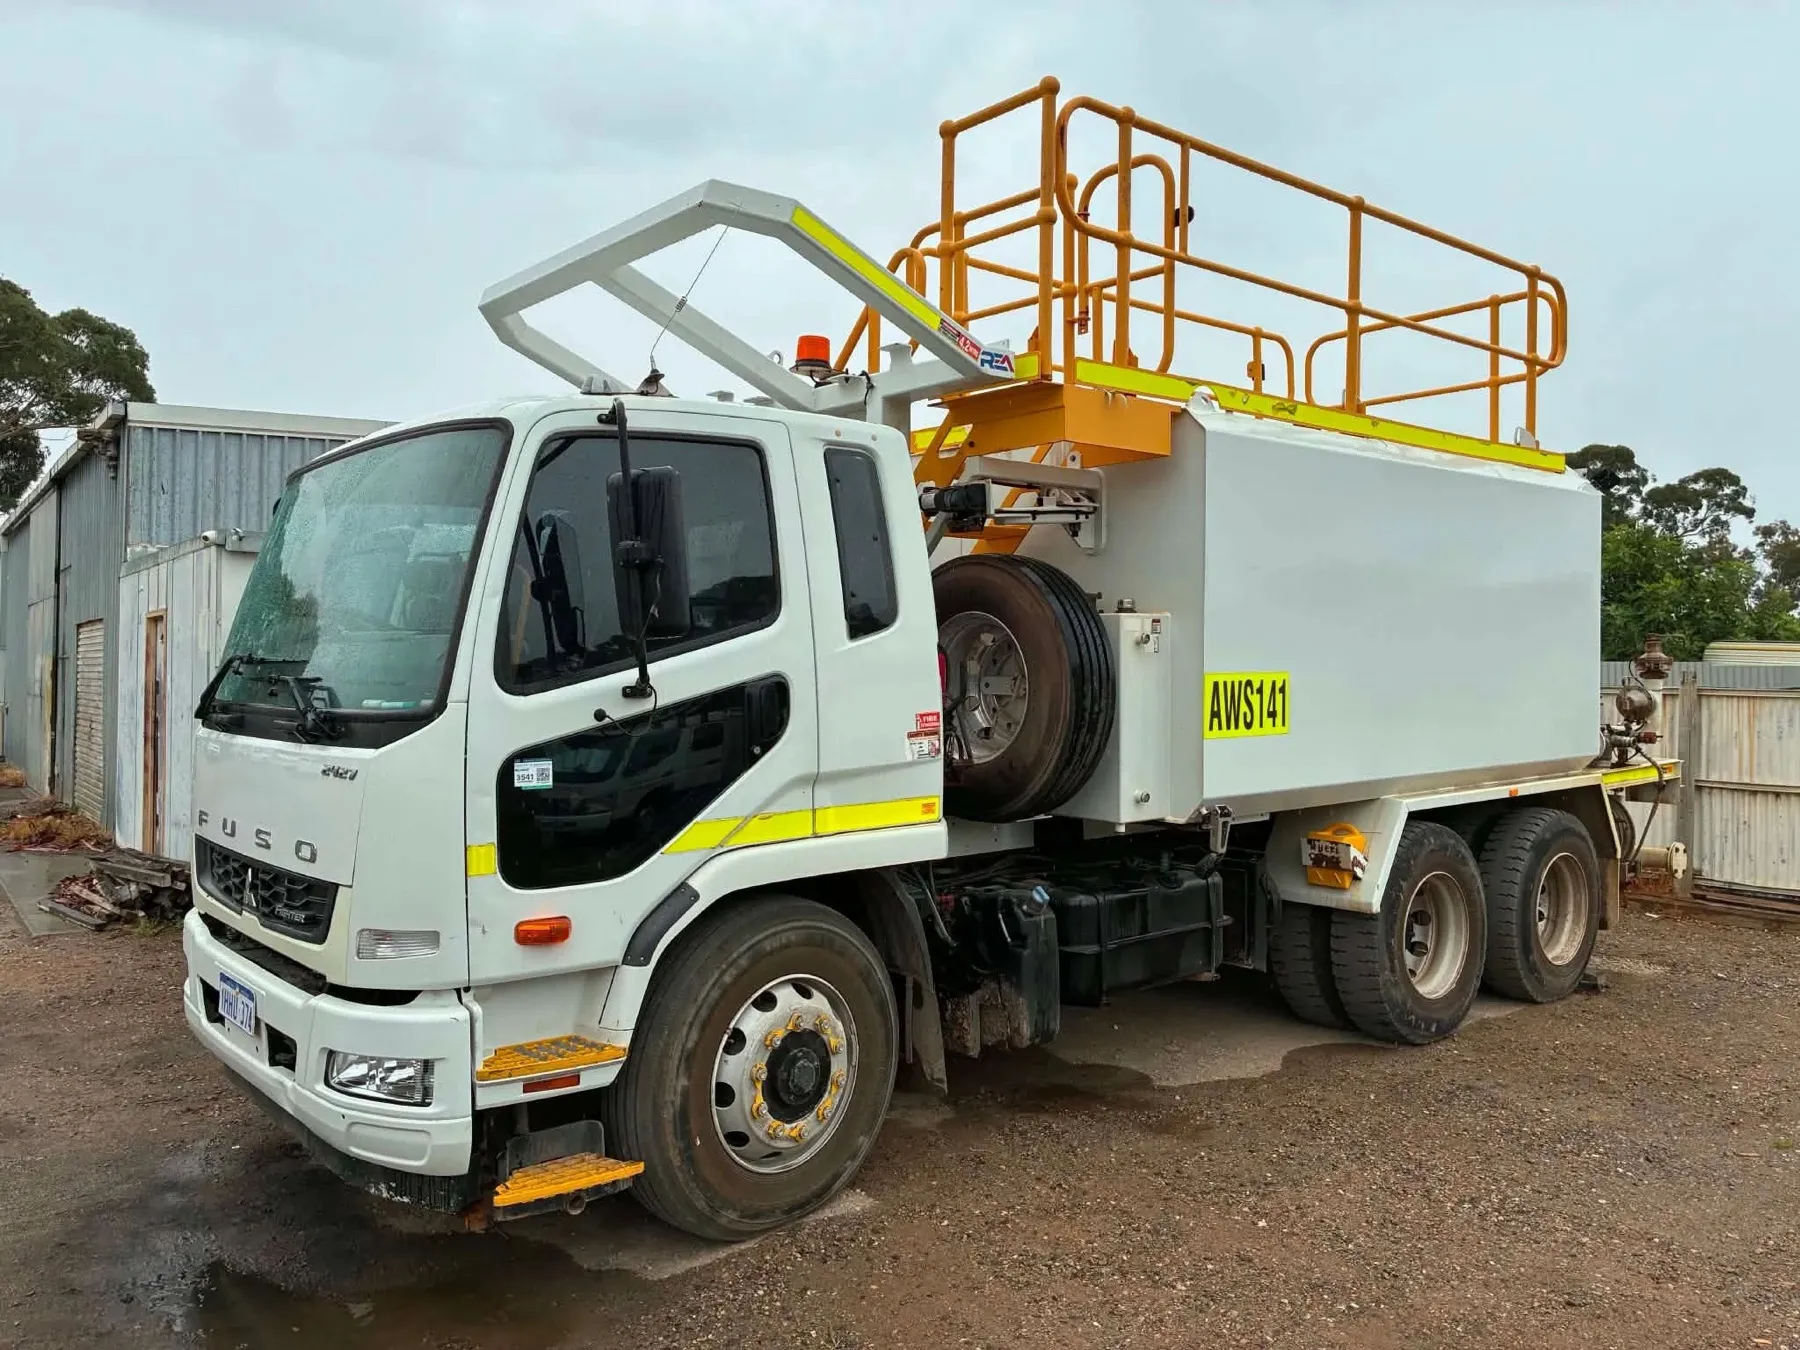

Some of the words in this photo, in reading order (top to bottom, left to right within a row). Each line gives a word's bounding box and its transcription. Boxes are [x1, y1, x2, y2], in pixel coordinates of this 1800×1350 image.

[1208, 678, 1286, 731] AWS141
[320, 762, 359, 781] 2427
[516, 773, 534, 781] 3541
[198, 809, 318, 864] FUSO
